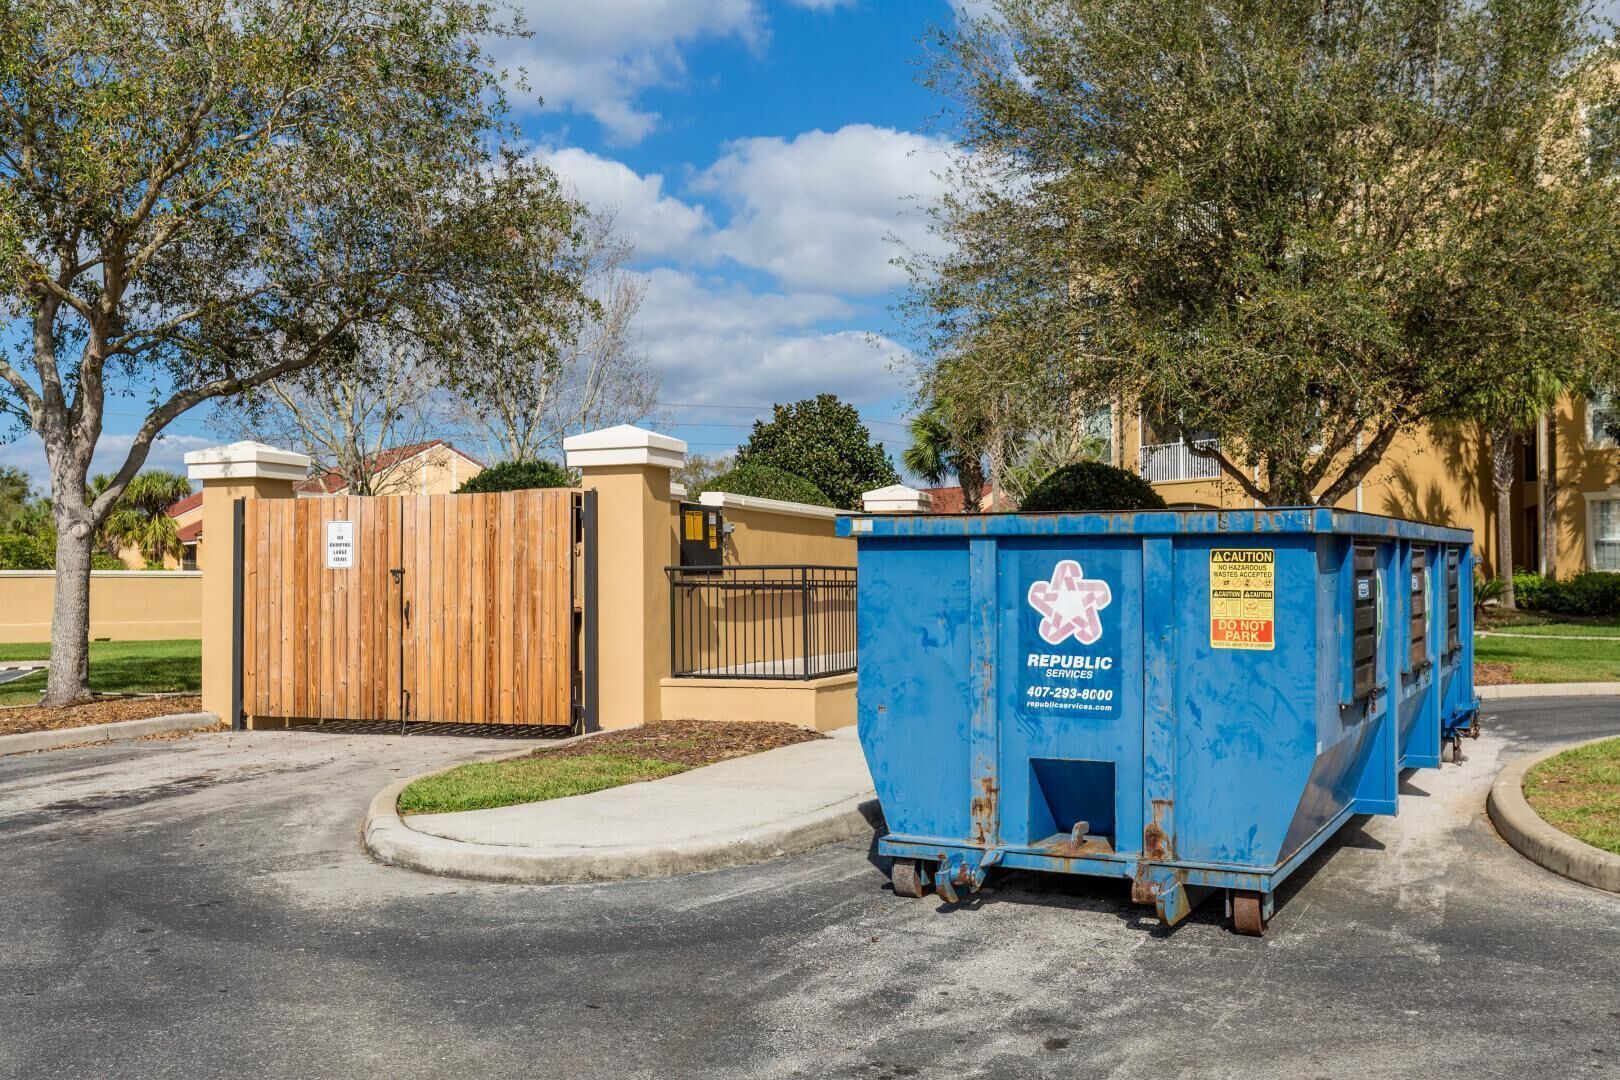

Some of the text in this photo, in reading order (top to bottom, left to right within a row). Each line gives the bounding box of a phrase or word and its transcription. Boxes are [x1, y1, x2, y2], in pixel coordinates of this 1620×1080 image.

[1223, 551, 1272, 562] CAUTION
[1218, 620, 1267, 632] DO NOT
[1225, 630, 1260, 642] PARK
[1027, 653, 1113, 670] REPUBLIC
[1045, 668, 1093, 679] SERVICES
[1026, 685, 1113, 701] 407-293-8000
[1026, 700, 1112, 711] republicservices.com
